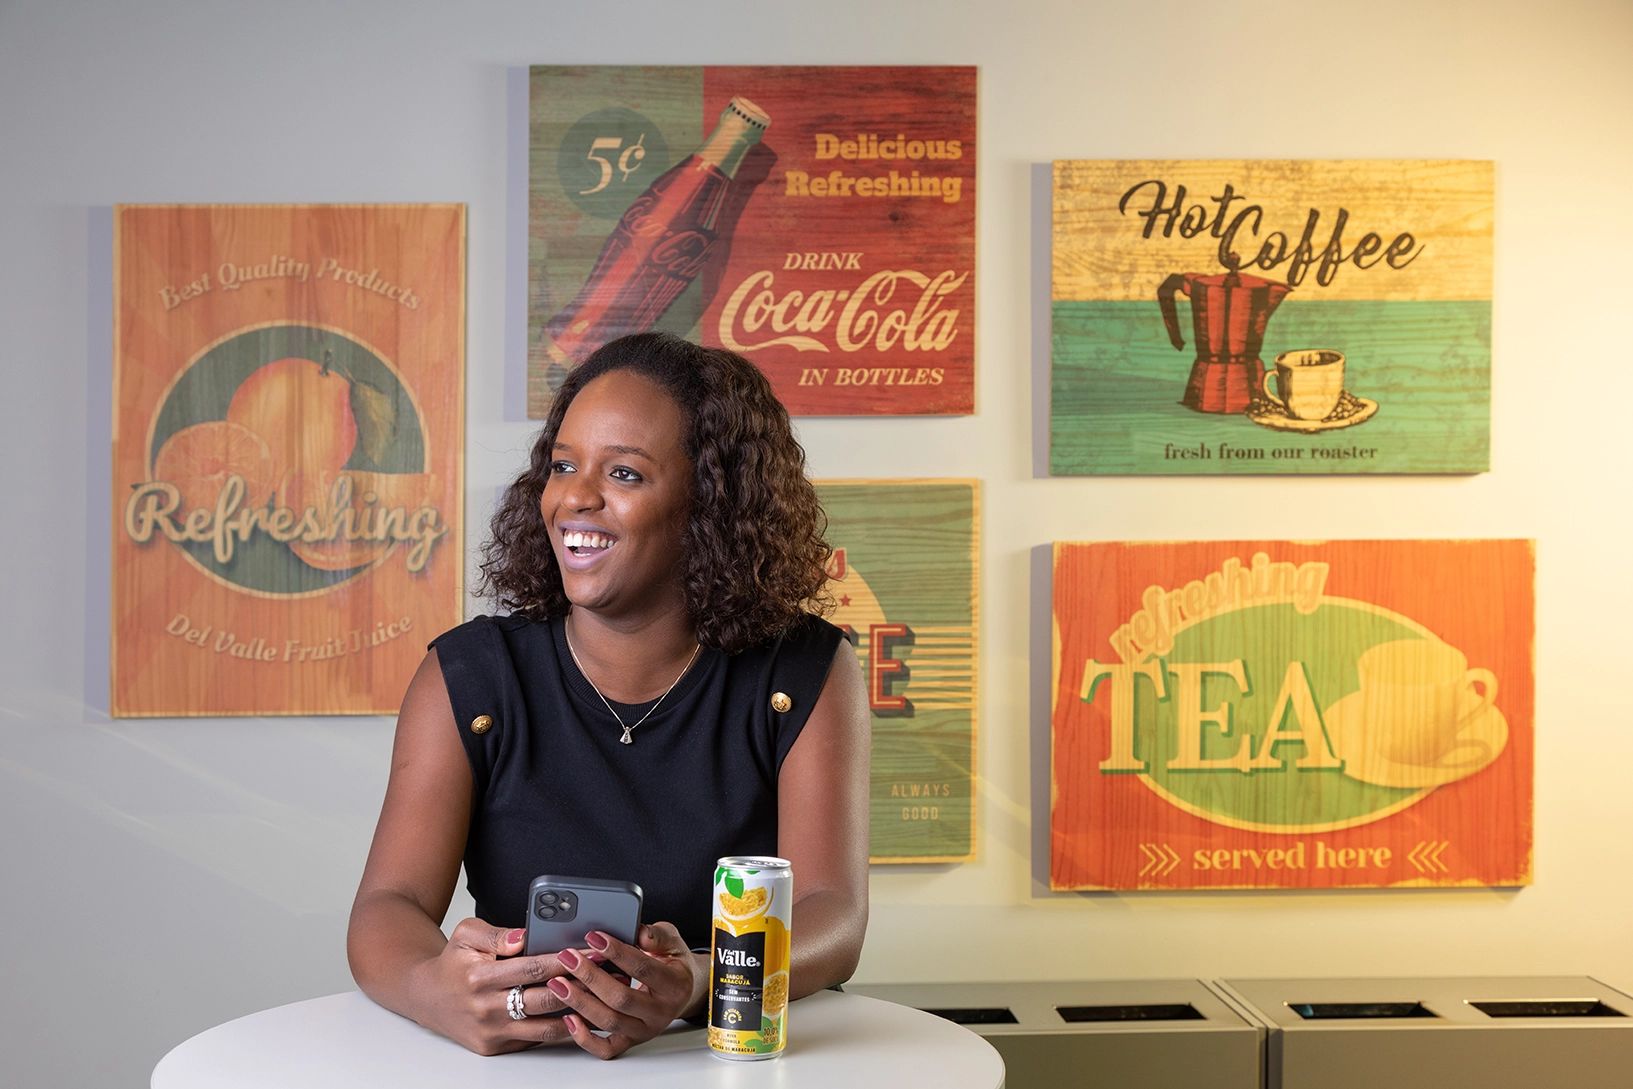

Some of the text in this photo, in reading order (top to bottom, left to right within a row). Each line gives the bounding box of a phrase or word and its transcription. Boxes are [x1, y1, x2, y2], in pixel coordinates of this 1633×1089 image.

[814, 133, 963, 160] Delicious
[784, 170, 963, 203] Refreshing
[1118, 179, 1246, 240] Hot
[782, 252, 864, 271] DRINK
[1217, 204, 1426, 288] Coffee
[158, 254, 420, 311] Best Quality Products
[717, 268, 970, 353] Coca-Cola
[797, 367, 945, 387] IN BOTTLES
[1163, 443, 1379, 461] fresh from our roaster
[124, 474, 449, 574] Refreshing
[1109, 551, 1330, 663] refreshing
[165, 613, 414, 663] Del Valle Fruit Juice
[1079, 657, 1346, 777] TEA
[890, 783, 951, 798] ALWAYS
[902, 806, 939, 821] GOOD
[1192, 841, 1393, 872] served here
[717, 947, 757, 967] Valle
